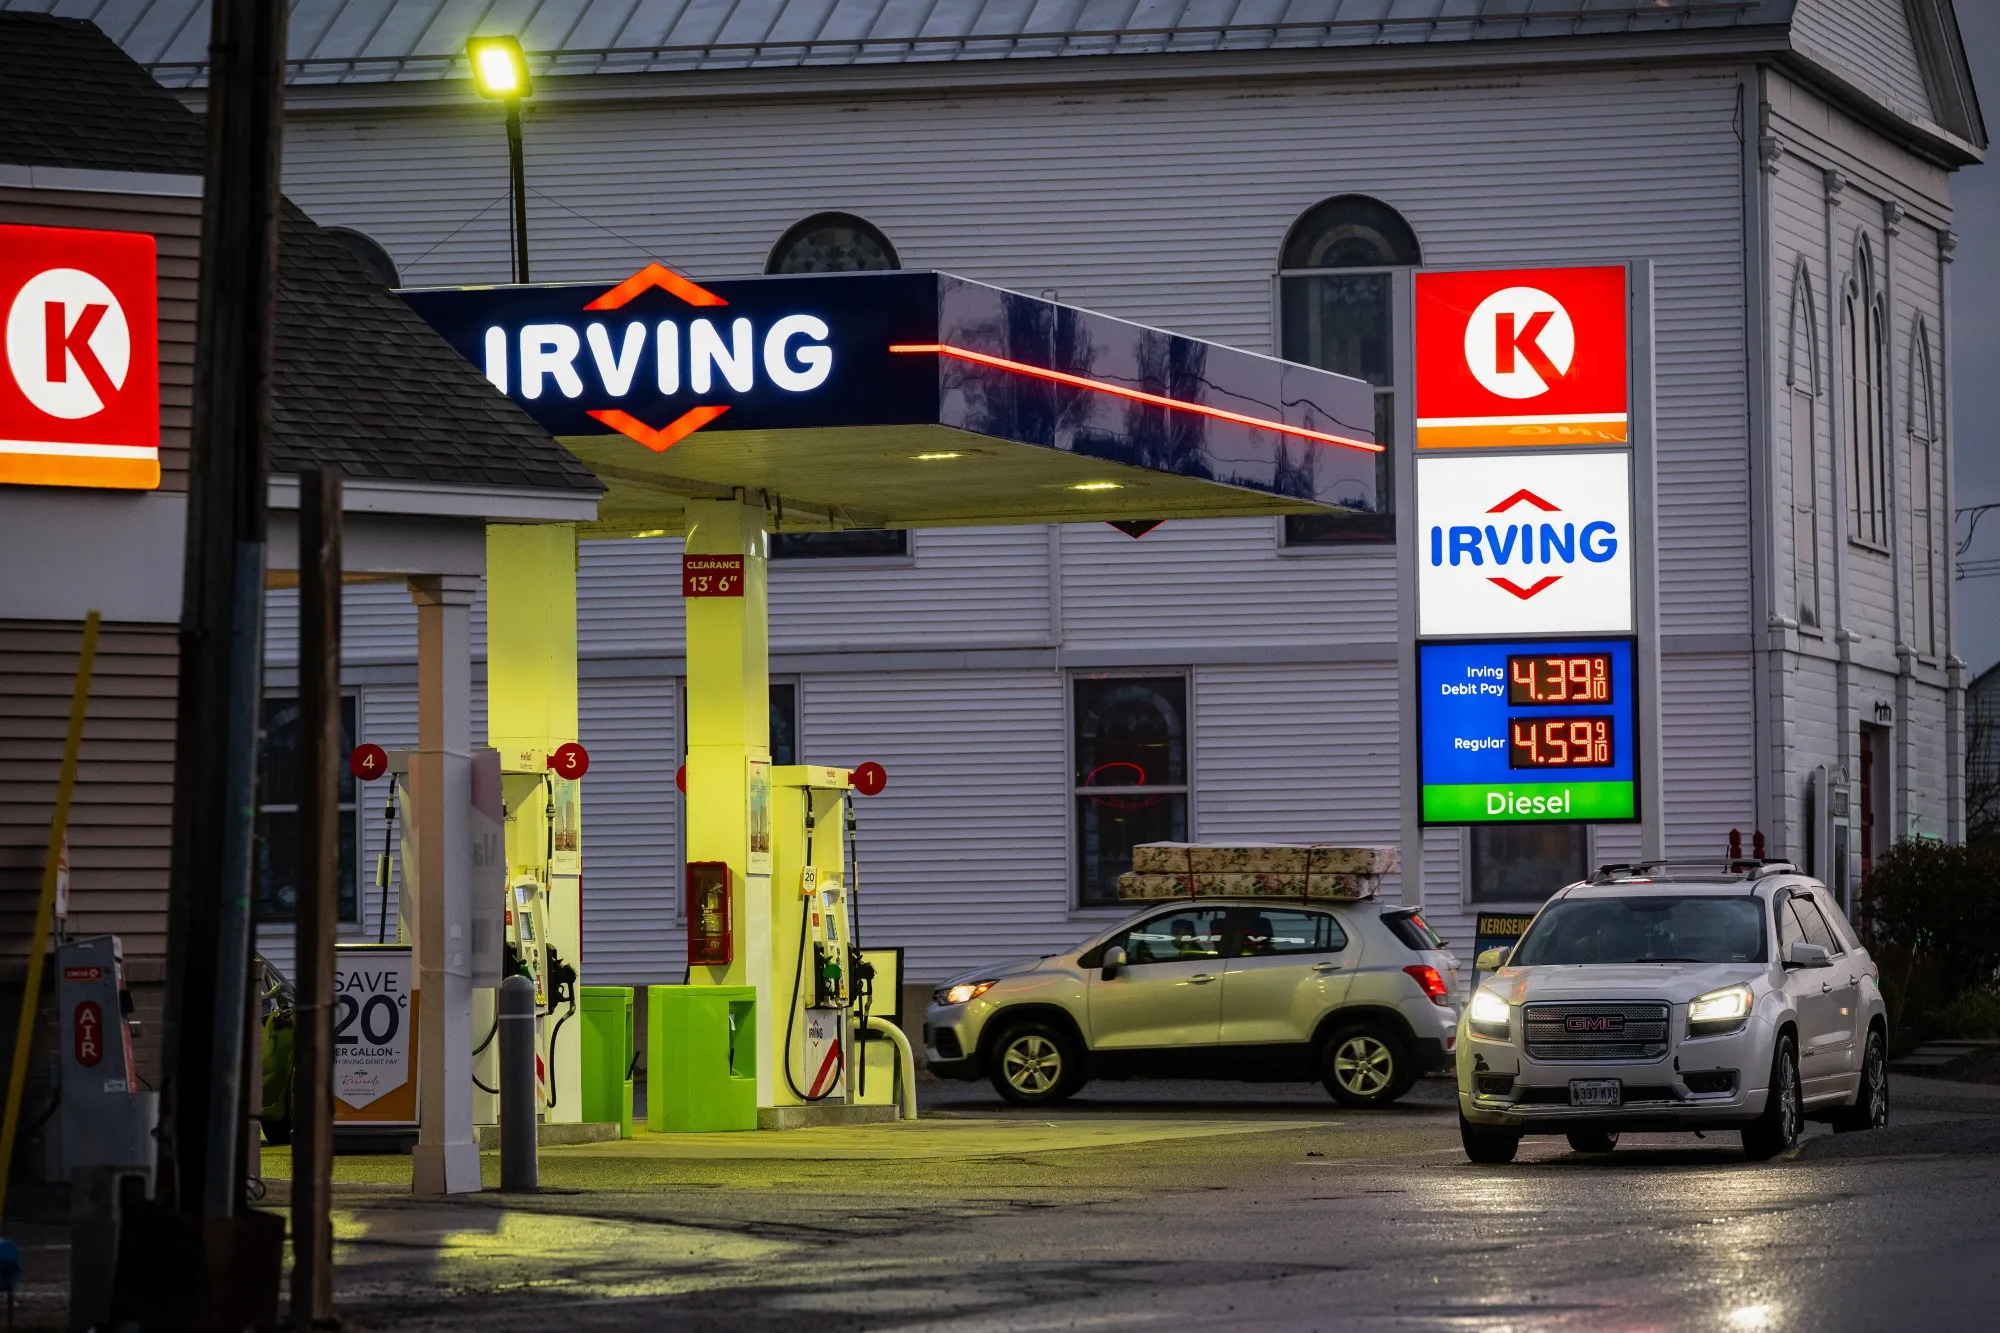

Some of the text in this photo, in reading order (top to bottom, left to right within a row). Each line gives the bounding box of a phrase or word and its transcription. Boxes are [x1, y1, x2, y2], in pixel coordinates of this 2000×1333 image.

[44, 300, 119, 408] K
[485, 314, 832, 400] IRVING
[1495, 311, 1564, 389] K
[1431, 521, 1618, 567] IRVING
[687, 561, 740, 569] CLEARANCE
[1467, 666, 1504, 680] Irving
[1513, 659, 1592, 700] 4.39
[1441, 683, 1505, 697] Debit Pay
[1454, 737, 1506, 752] Regular
[1514, 722, 1592, 763] 4.59
[362, 753, 375, 769] 4
[565, 752, 577, 769] 3
[866, 770, 874, 785] 1
[1487, 789, 1570, 815] Diesel
[334, 971, 398, 993] SAVE
[79, 1008, 98, 1058] AIR
[1566, 1016, 1623, 1031] GMC
[350, 1048, 393, 1057] GALLON
